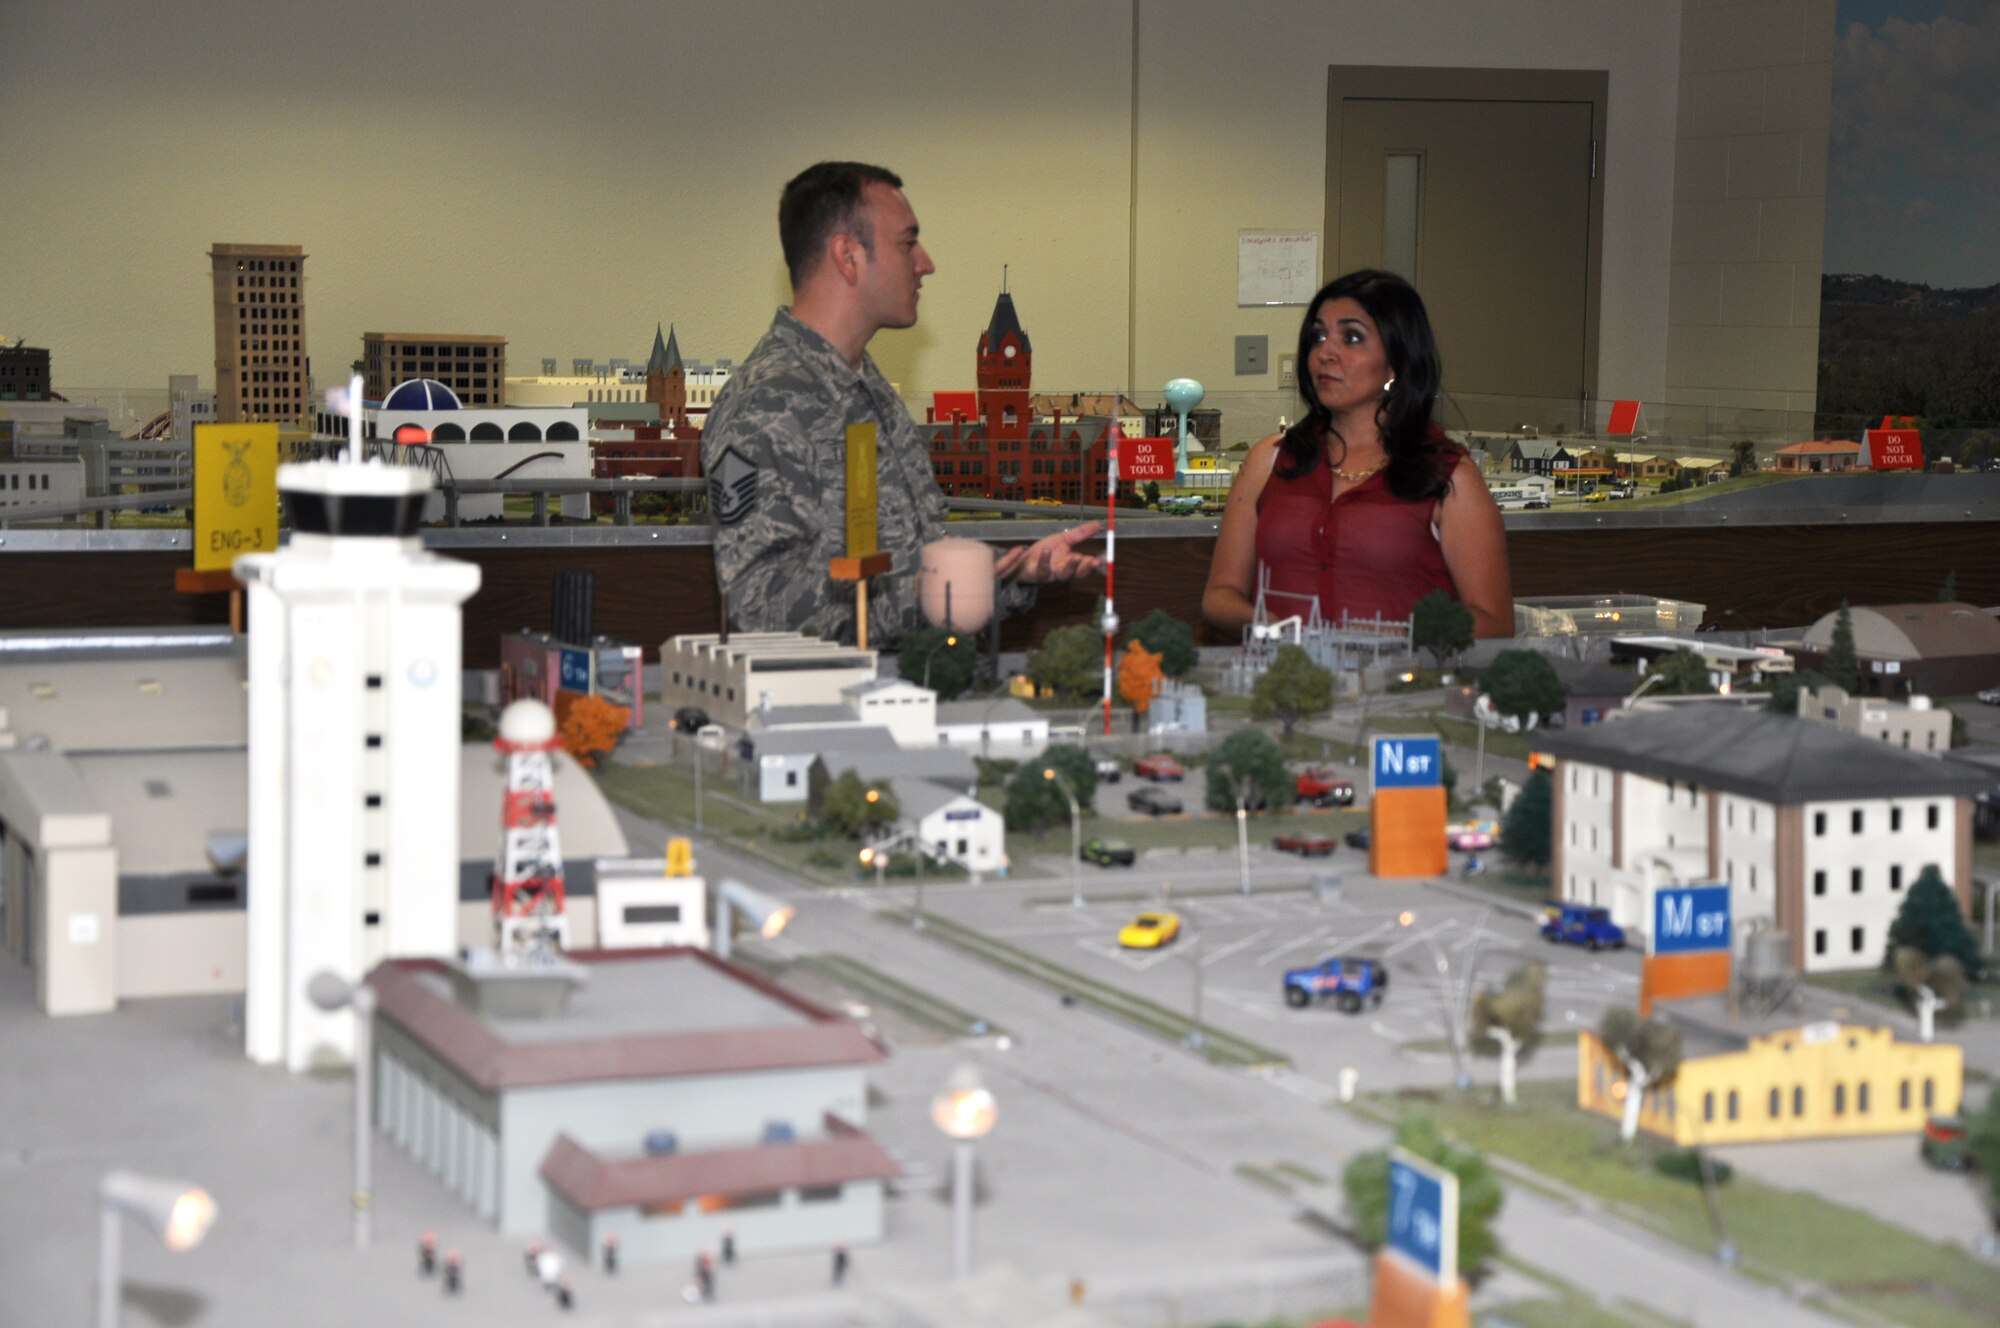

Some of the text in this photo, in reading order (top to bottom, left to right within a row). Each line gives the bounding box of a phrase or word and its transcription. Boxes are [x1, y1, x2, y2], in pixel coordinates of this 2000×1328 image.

[1887, 435, 1901, 445] DO
[1137, 444, 1152, 454] DO
[1886, 445, 1905, 454] NOT
[1135, 455, 1156, 464] NOT
[1881, 455, 1913, 464] TOUCH
[1130, 465, 1164, 475] TOUCH
[210, 528, 262, 552] ENG-3
[1381, 742, 1431, 775] N ST
[1662, 893, 1728, 938] M ST
